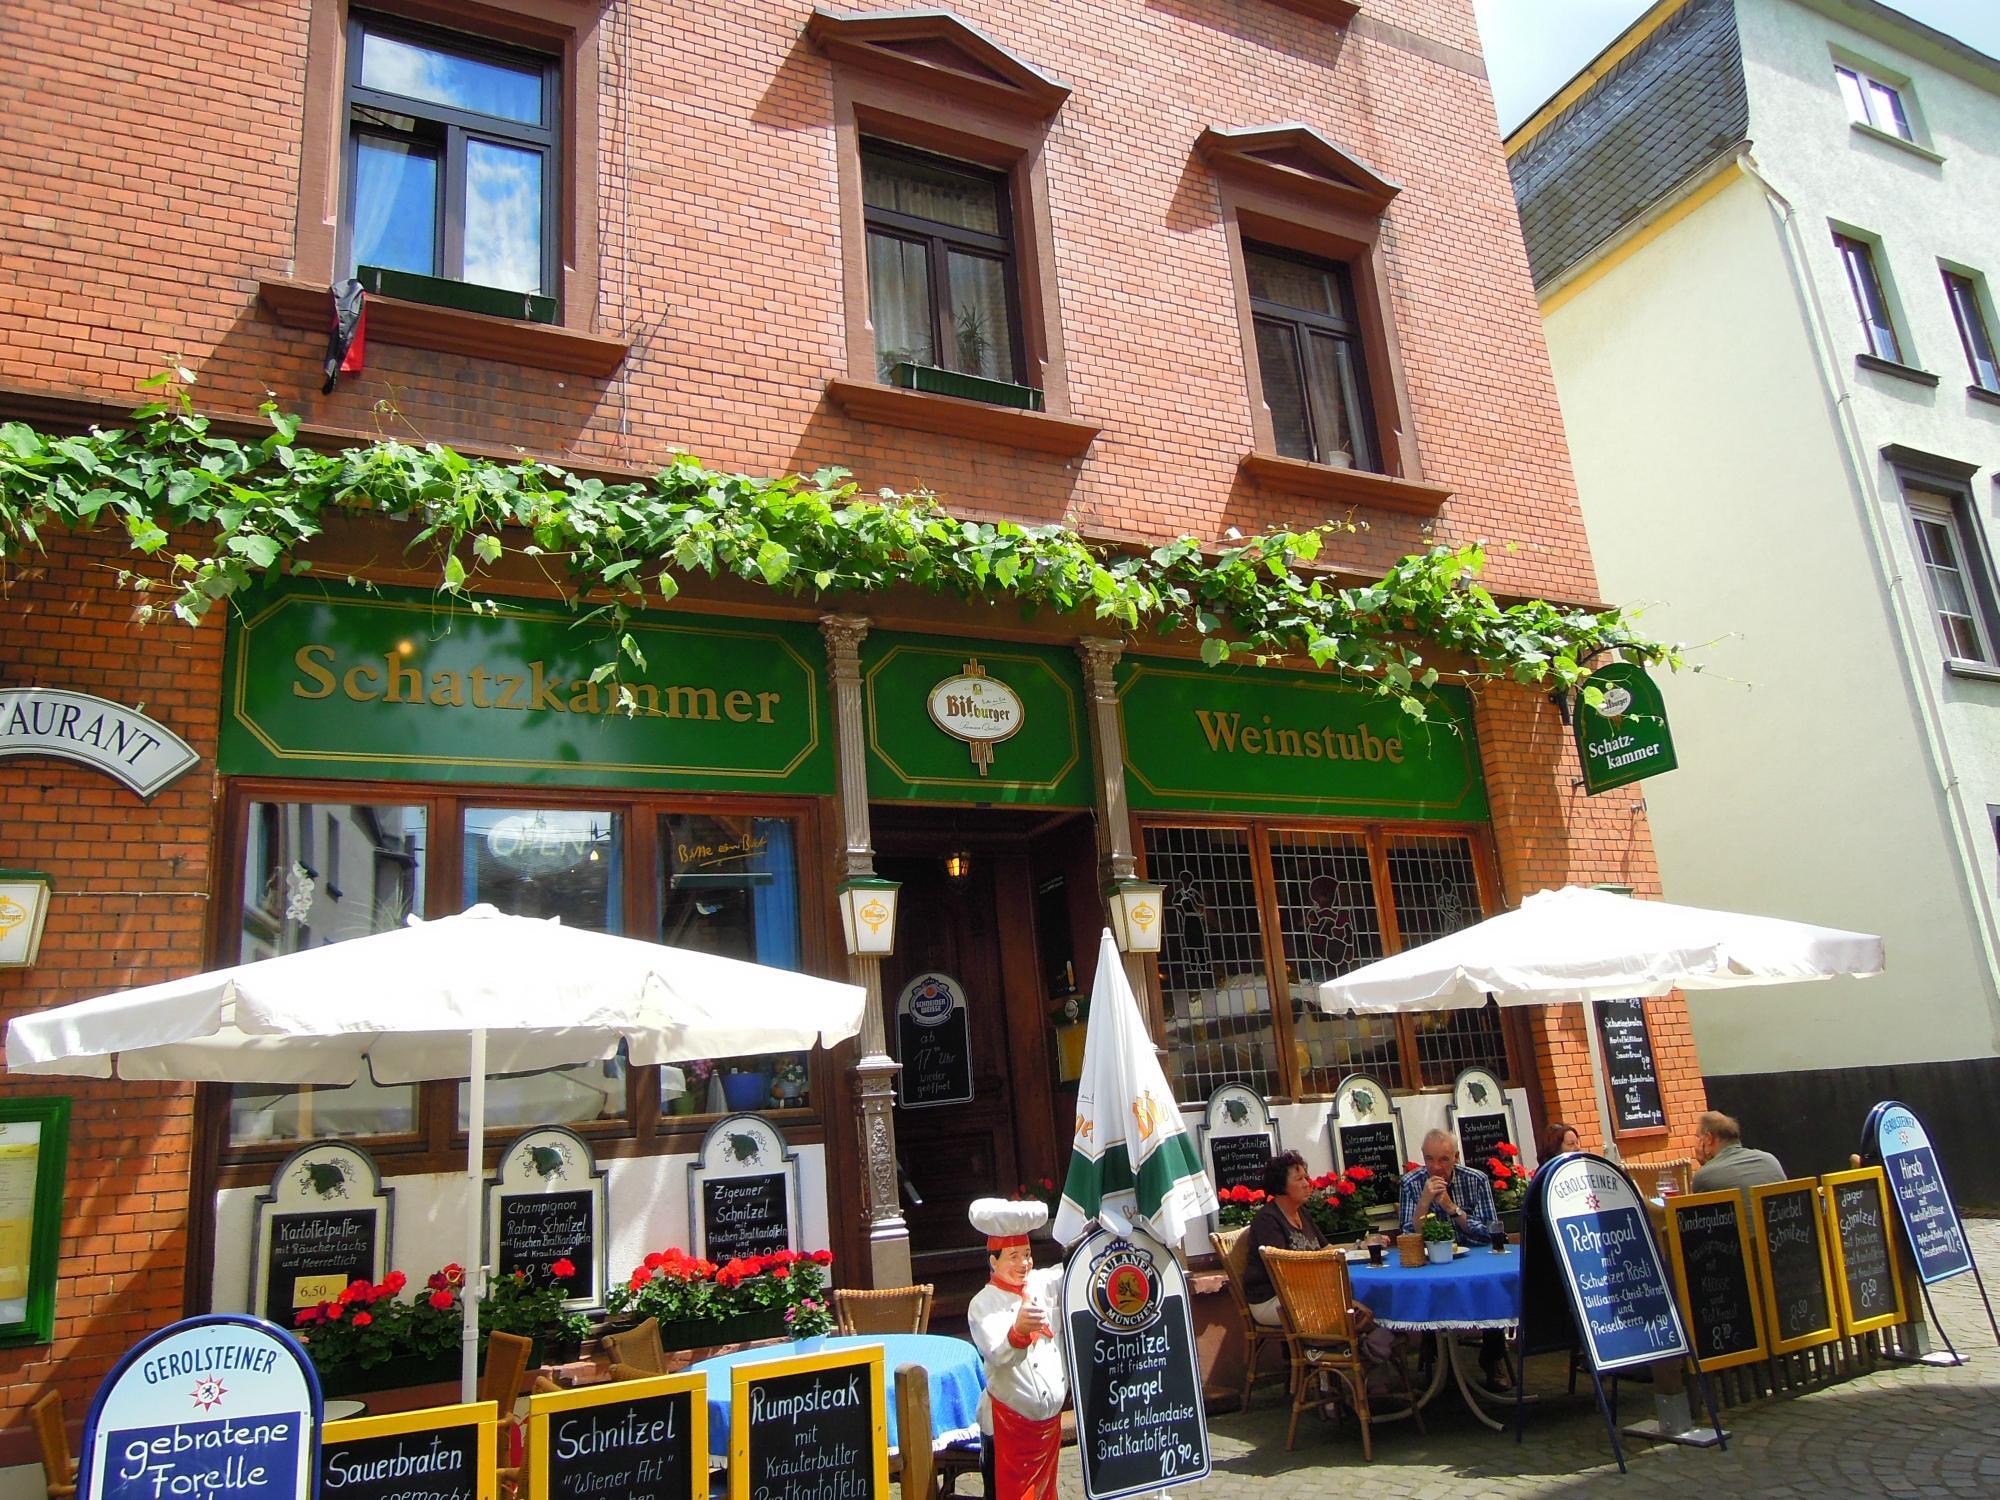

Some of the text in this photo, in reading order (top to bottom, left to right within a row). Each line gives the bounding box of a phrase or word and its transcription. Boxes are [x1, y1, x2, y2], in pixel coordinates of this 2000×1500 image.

[292, 643, 780, 724] Schatzkammer
[946, 694, 1011, 722] Bitburger
[1195, 708, 1405, 763] Weinstube
[1588, 735, 1635, 758] Schatz-
[1606, 743, 1660, 770] kammer
[492, 828, 586, 858] OPEN
[916, 998, 946, 1008] SCHNEIDER
[920, 1004, 942, 1014] WEISSE
[920, 1030, 936, 1044] ab
[938, 1052, 957, 1064] Uhr
[1883, 1115, 1915, 1135] GEROLSTEINER
[1554, 1174, 1618, 1199] GEROLSTEINER
[508, 1201, 576, 1216] Champignon
[716, 1199, 768, 1222] Schnitzel
[281, 1218, 361, 1243] Kartoffelpuffer
[734, 1221, 747, 1229] mit
[1566, 1213, 1637, 1255] Rehragout
[1840, 1207, 1877, 1236] Schnitzel
[500, 1238, 513, 1246] mit
[513, 1236, 541, 1249] frischen
[709, 1230, 738, 1245] frischen
[1768, 1221, 1810, 1253] Schnitzel
[282, 1254, 357, 1268] und Meerrettich
[531, 1247, 573, 1257] Krautsalat
[1601, 1251, 1616, 1268] mit
[1097, 1254, 1153, 1289] PAULANER
[1580, 1257, 1652, 1290] Schweizer Rösti
[300, 1285, 327, 1297] 6.50
[1106, 1299, 1155, 1326] MÜNCHEN
[1617, 1301, 1635, 1315] und
[1590, 1315, 1645, 1336] Preiselbeeren
[1094, 1325, 1171, 1363] Schnitzel
[143, 1346, 277, 1385] GEROLSTEINER
[1109, 1355, 1167, 1375] mit frischem
[1108, 1370, 1163, 1412] Spargel
[557, 1401, 676, 1459] Schnitzel
[1097, 1401, 1194, 1434] Sauce Hollandaise
[795, 1424, 818, 1447] mit
[120, 1419, 289, 1480] gebratene
[325, 1434, 462, 1488] Sauerbraten
[766, 1442, 859, 1479] Kräuterbutter
[147, 1455, 268, 1499] Forelle
